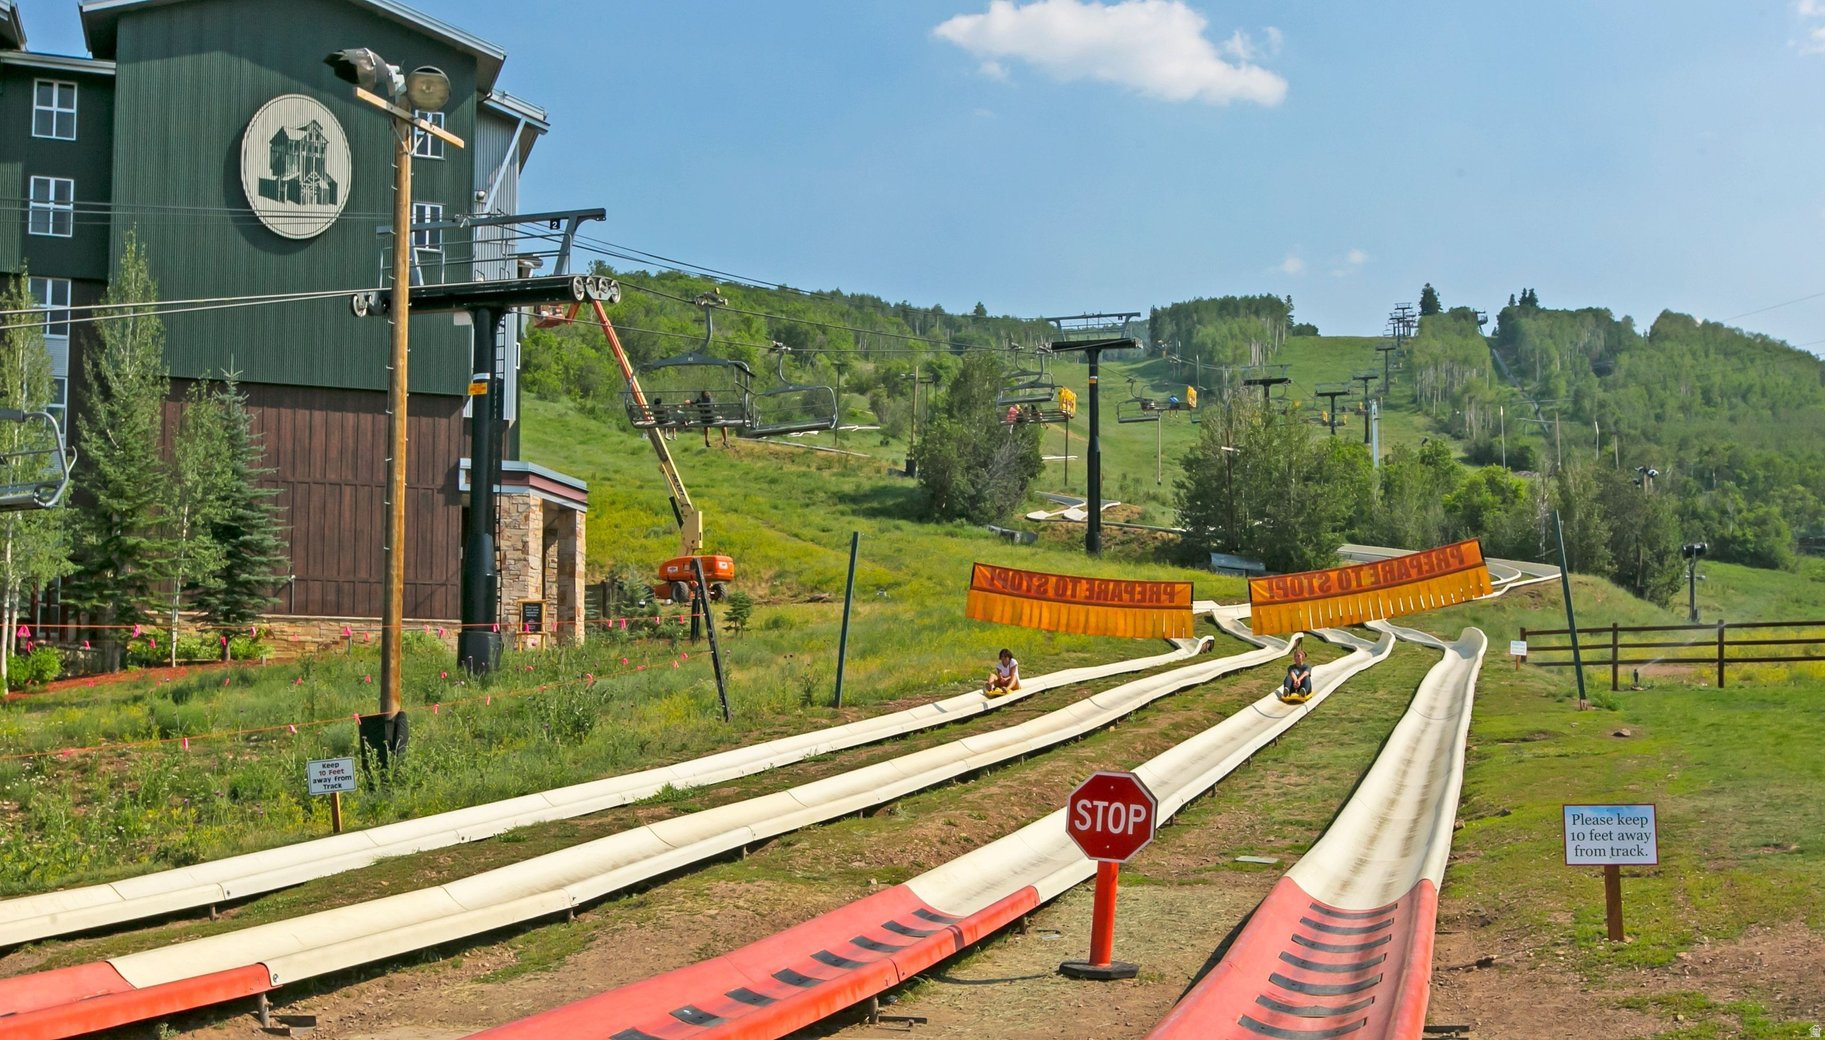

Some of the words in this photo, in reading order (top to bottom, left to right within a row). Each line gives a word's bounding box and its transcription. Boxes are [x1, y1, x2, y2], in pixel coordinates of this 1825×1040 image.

[552, 221, 558, 229] 2
[1074, 799, 1147, 835] STOP
[1571, 813, 1614, 826] Please
[1617, 813, 1649, 828] keep
[1570, 831, 1586, 842] 10
[1589, 829, 1614, 842] feet
[1617, 832, 1652, 844] away
[1574, 845, 1607, 857] from
[1610, 844, 1649, 857] track.
